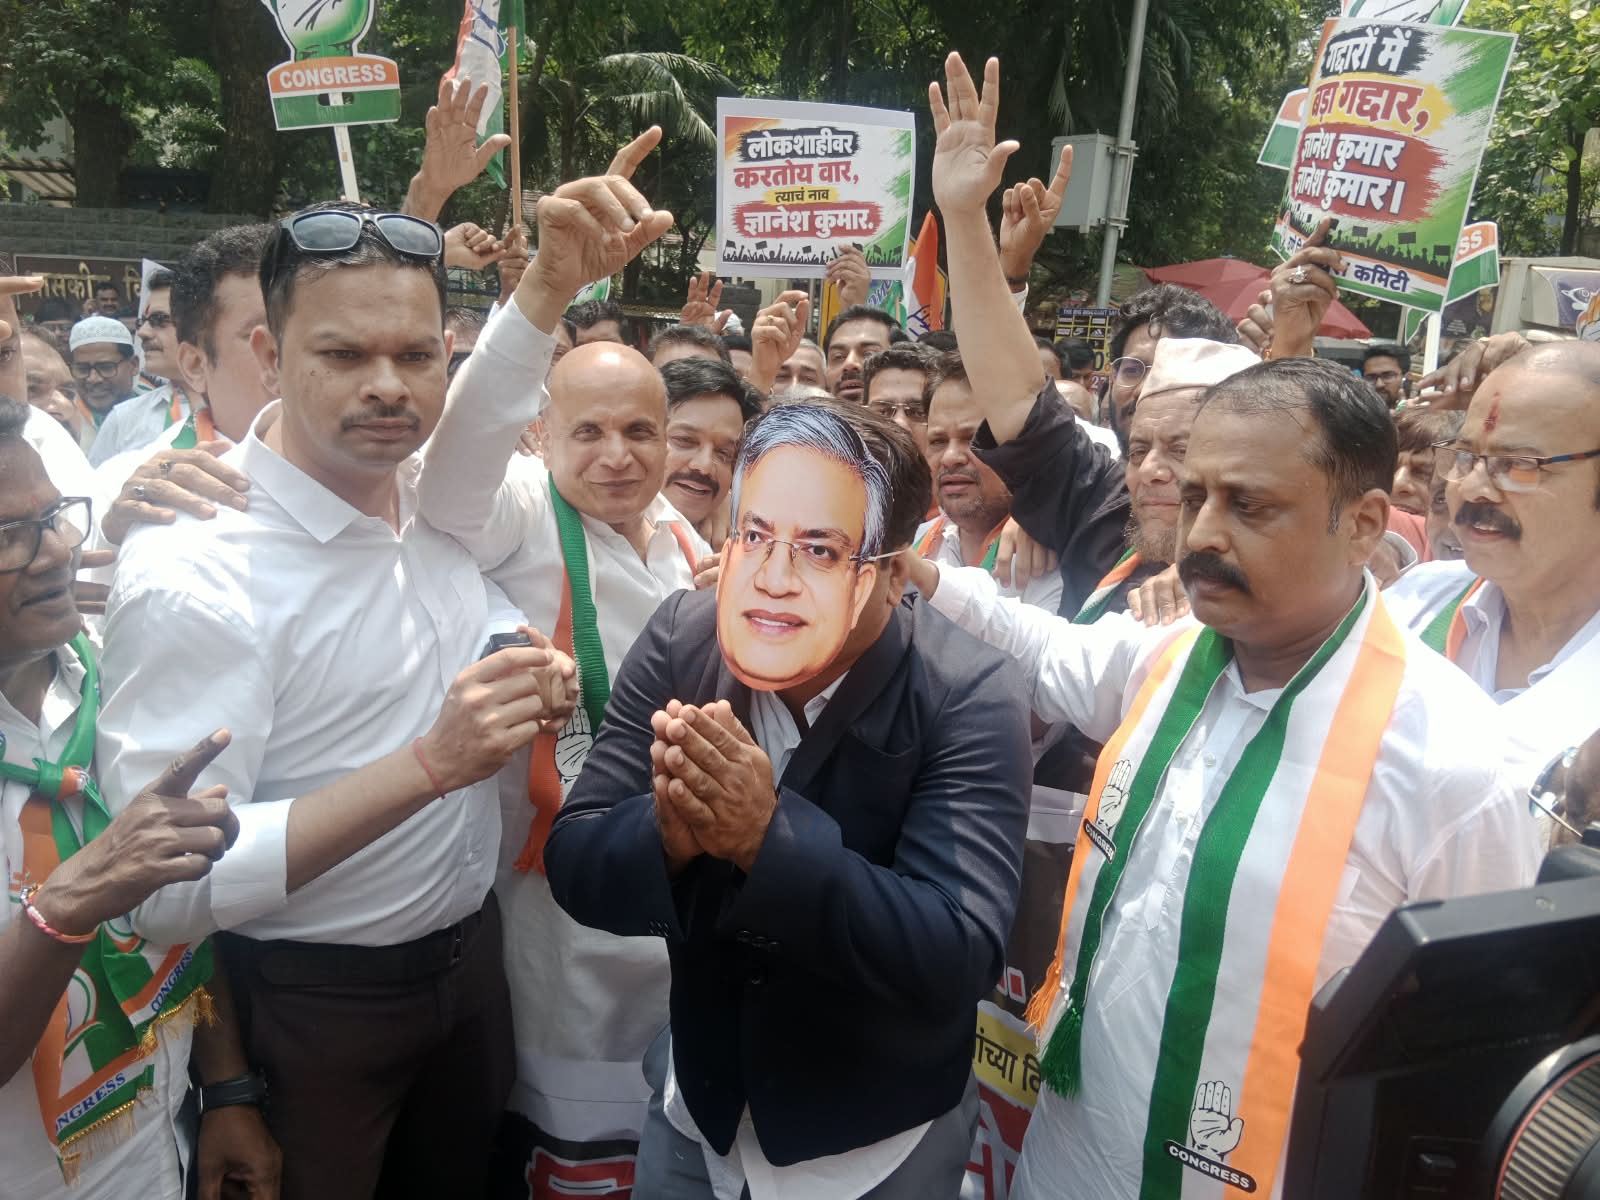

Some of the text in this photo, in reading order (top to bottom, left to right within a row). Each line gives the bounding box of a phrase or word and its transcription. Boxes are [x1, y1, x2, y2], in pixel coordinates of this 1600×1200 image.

[1325, 26, 1412, 73] गद्दारों में
[280, 63, 387, 89] CONGRESS
[1338, 80, 1429, 132] गद्दार,
[747, 127, 853, 158] लोकशाहीवर
[1301, 127, 1405, 171] ज्ञानेश कुमार
[733, 160, 859, 189] करतोय वार,
[775, 187, 829, 203] त्याचं नाव
[743, 206, 874, 238] ज्ञानेश कुमार.
[1353, 264, 1410, 293] कमिटी
[972, 1028, 1019, 1084] ांच्या
[56, 1072, 126, 1132] NGRESS
[1169, 1145, 1249, 1188] CONGRESS
